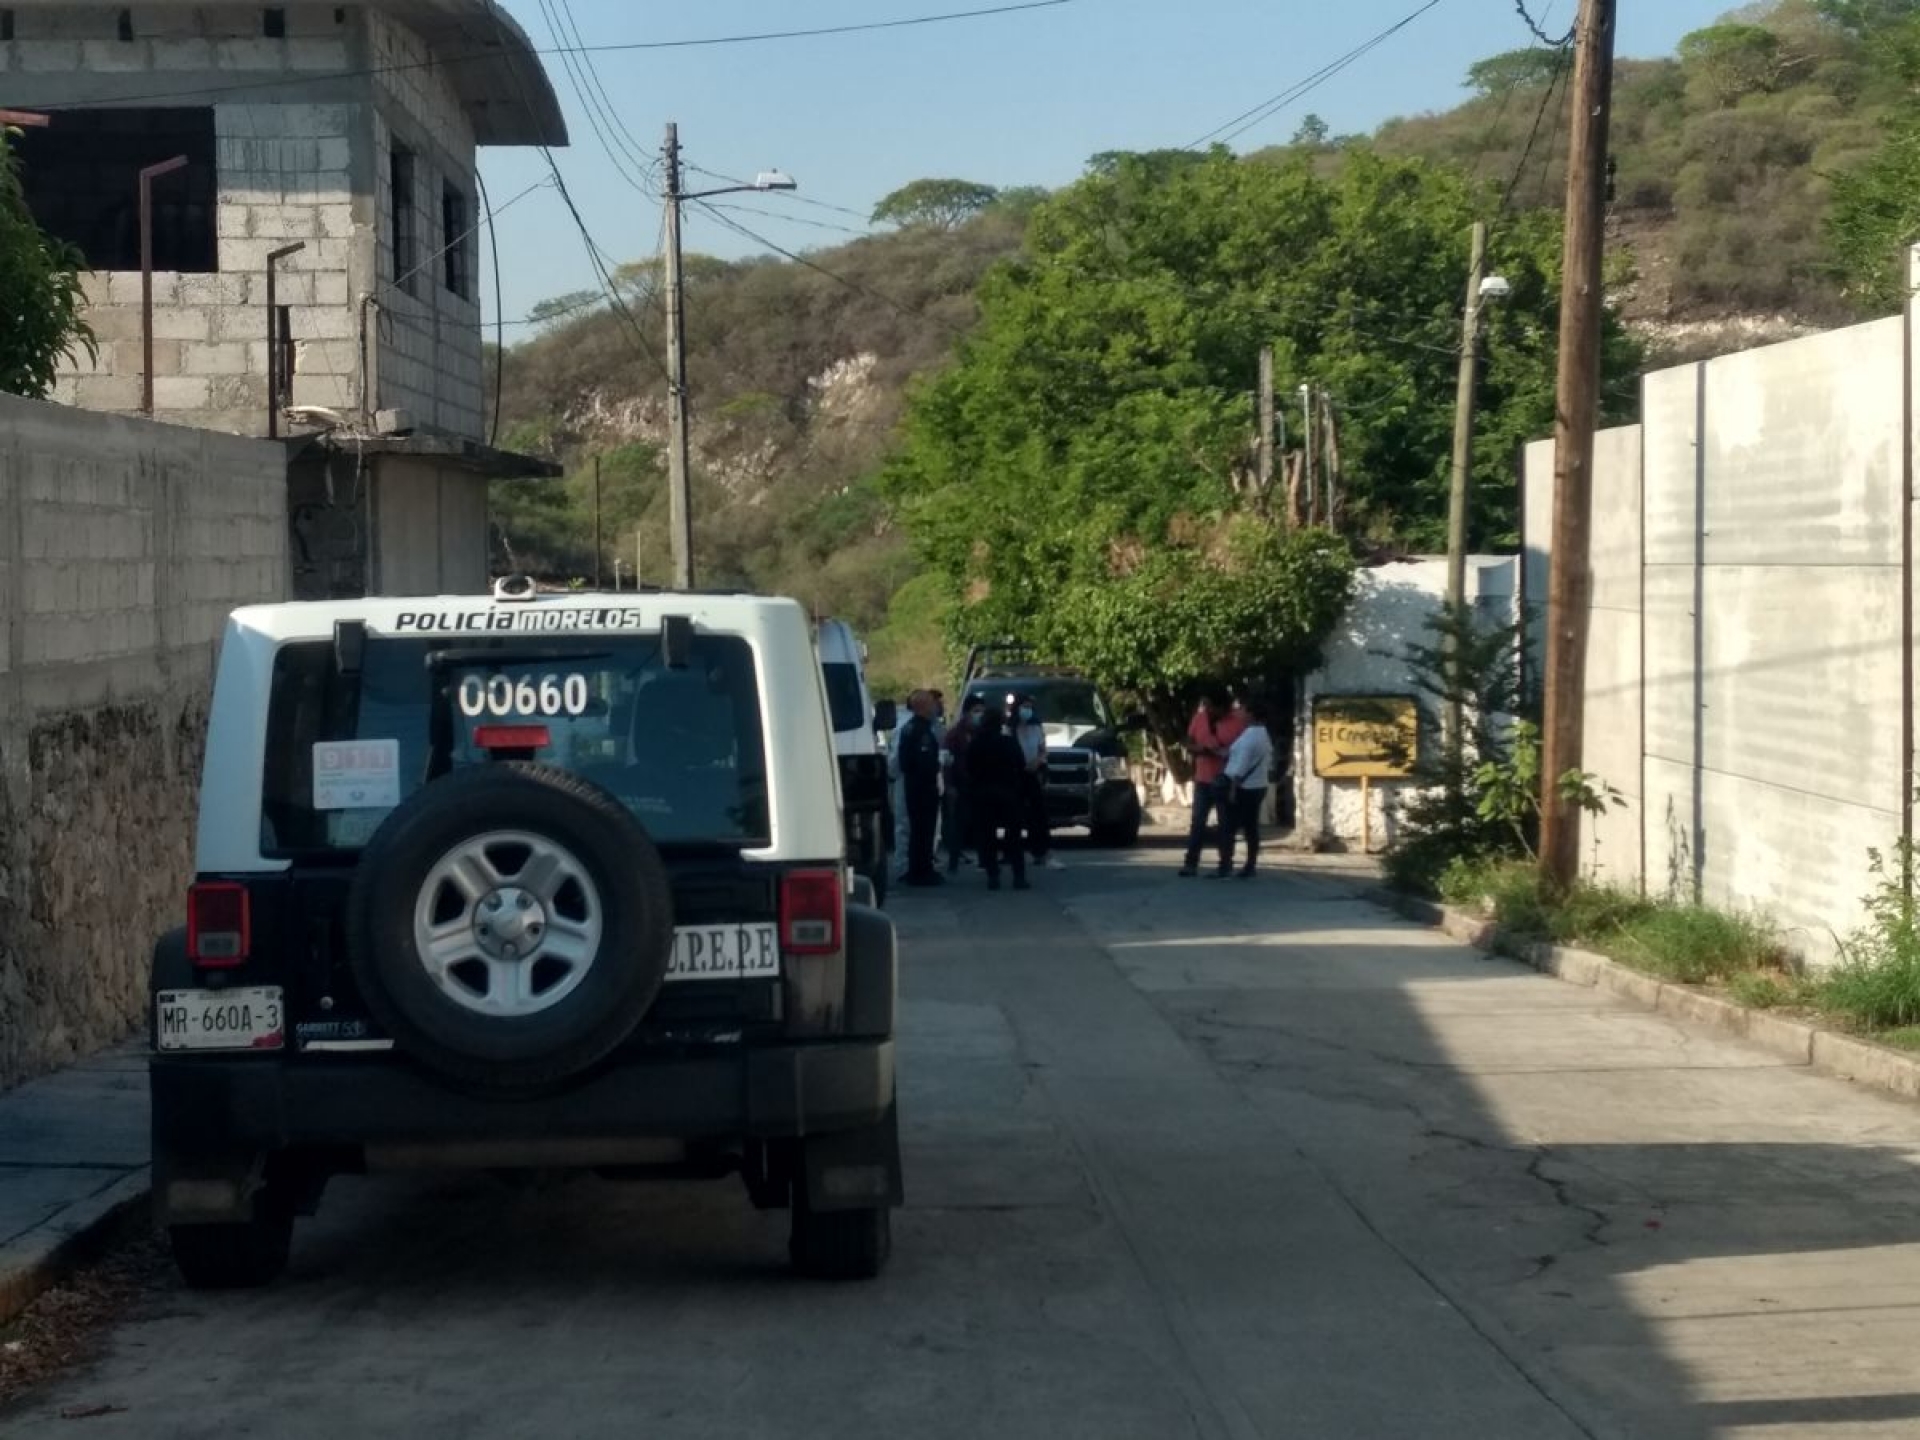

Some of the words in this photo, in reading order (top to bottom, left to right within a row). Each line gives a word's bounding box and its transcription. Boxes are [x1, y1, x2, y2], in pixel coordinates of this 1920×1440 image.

[517, 607, 642, 632] MORELOS
[459, 673, 588, 717] 00660
[163, 1003, 279, 1034] MR-660A-3
